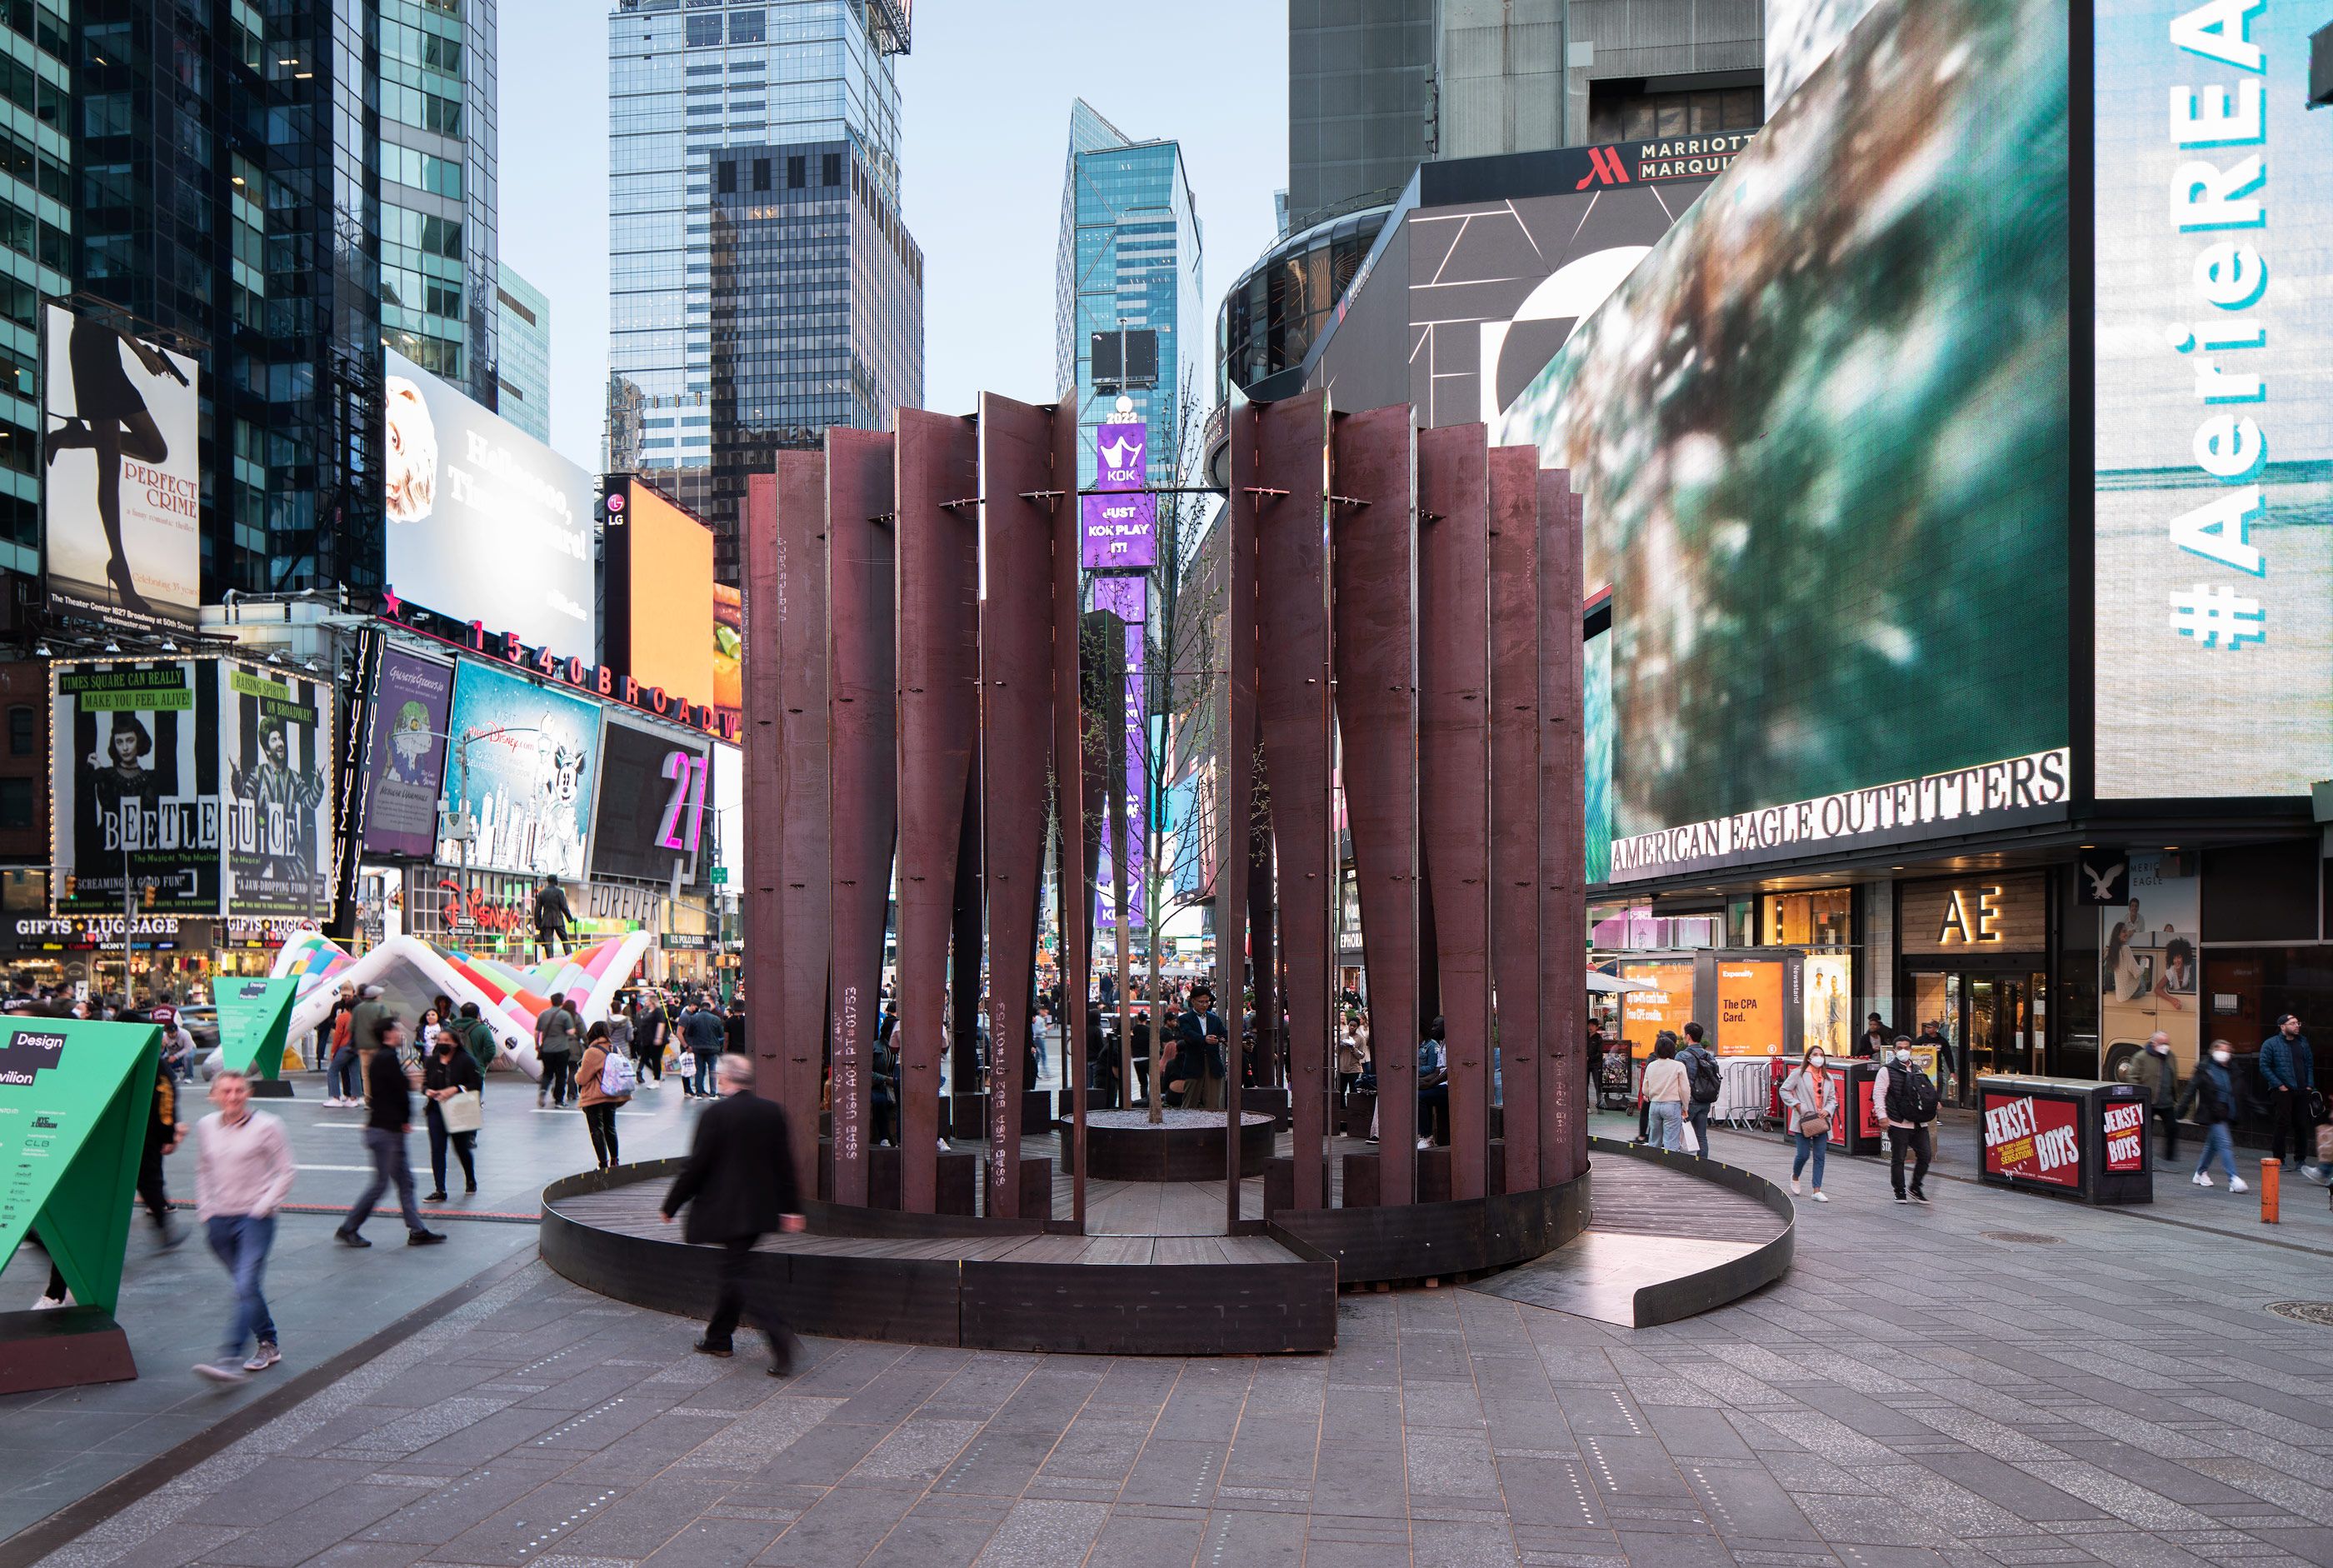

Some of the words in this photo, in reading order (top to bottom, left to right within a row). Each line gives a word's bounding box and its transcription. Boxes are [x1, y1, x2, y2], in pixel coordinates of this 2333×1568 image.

[1641, 157, 1737, 177] MARQUI
[1107, 412, 1137, 424] 2022
[124, 461, 197, 499] PERFECT
[1107, 470, 1135, 482] KOK
[147, 489, 197, 519] CRIME
[1102, 507, 1136, 518] JUST
[608, 515, 623, 526] LG
[1088, 525, 1115, 537] KOK
[1116, 524, 1149, 536] PLAY
[1111, 542, 1127, 553] IT!
[132, 572, 170, 592] Celebrating
[51, 593, 64, 603] The
[65, 597, 88, 609] Theater
[91, 601, 111, 614] Center
[112, 607, 126, 617] 1627
[127, 610, 156, 624] Broadway
[156, 616, 162, 624] at
[163, 617, 177, 628] 50th
[177, 620, 195, 632] Street
[103, 615, 151, 632] ticketmaster.com
[469, 620, 582, 684] 1540
[62, 675, 89, 690] TIMES
[91, 672, 125, 690] SQUARE
[127, 672, 145, 687] CAN
[148, 670, 182, 686] REALLY
[236, 675, 262, 696] RAISING
[262, 683, 287, 700] SPIRITS
[85, 694, 111, 707] MAKE
[114, 693, 132, 707] YOU
[135, 692, 157, 707] FEEL
[161, 692, 190, 706] ALIVE!
[267, 700, 276, 714] ON
[277, 702, 312, 722] BROADWAY!
[1611, 819, 1721, 872] AMERICAN
[1729, 800, 1815, 854] EAGLE
[1821, 751, 2066, 837] OUTFITTERS
[103, 795, 220, 851] BEETLE
[133, 854, 146, 862] The
[178, 853, 190, 862] The
[77, 876, 134, 891] SCREAMINGY
[245, 879, 289, 892] JAW-DROPPING
[2133, 877, 2163, 886] EAGLE
[589, 884, 662, 921] FOREVER
[1938, 886, 2000, 943] AE
[16, 920, 72, 934] GIFTS
[87, 918, 179, 933] LUGGAGE
[227, 919, 262, 931] GIFTS
[679, 935, 691, 944] POLO
[1626, 1008, 1636, 1020] Free
[1723, 1000, 1739, 1009] The
[1741, 1000, 1757, 1009] CPA
[483, 1017, 499, 1035] Pratt
[846, 986, 857, 1056] PT#01753
[1723, 1011, 1746, 1022] Card.
[17, 1033, 63, 1048] Design
[846, 1092, 857, 1121] USA
[1985, 1096, 2037, 1146] JERSEY
[2104, 1103, 2143, 1133] JERSEY
[996, 1115, 1006, 1144] USA
[846, 1125, 857, 1160] SSAB
[2034, 1125, 2079, 1172] BOYS
[2107, 1135, 2141, 1163] BOYS
[2001, 1148, 2034, 1166] SENSATION!
